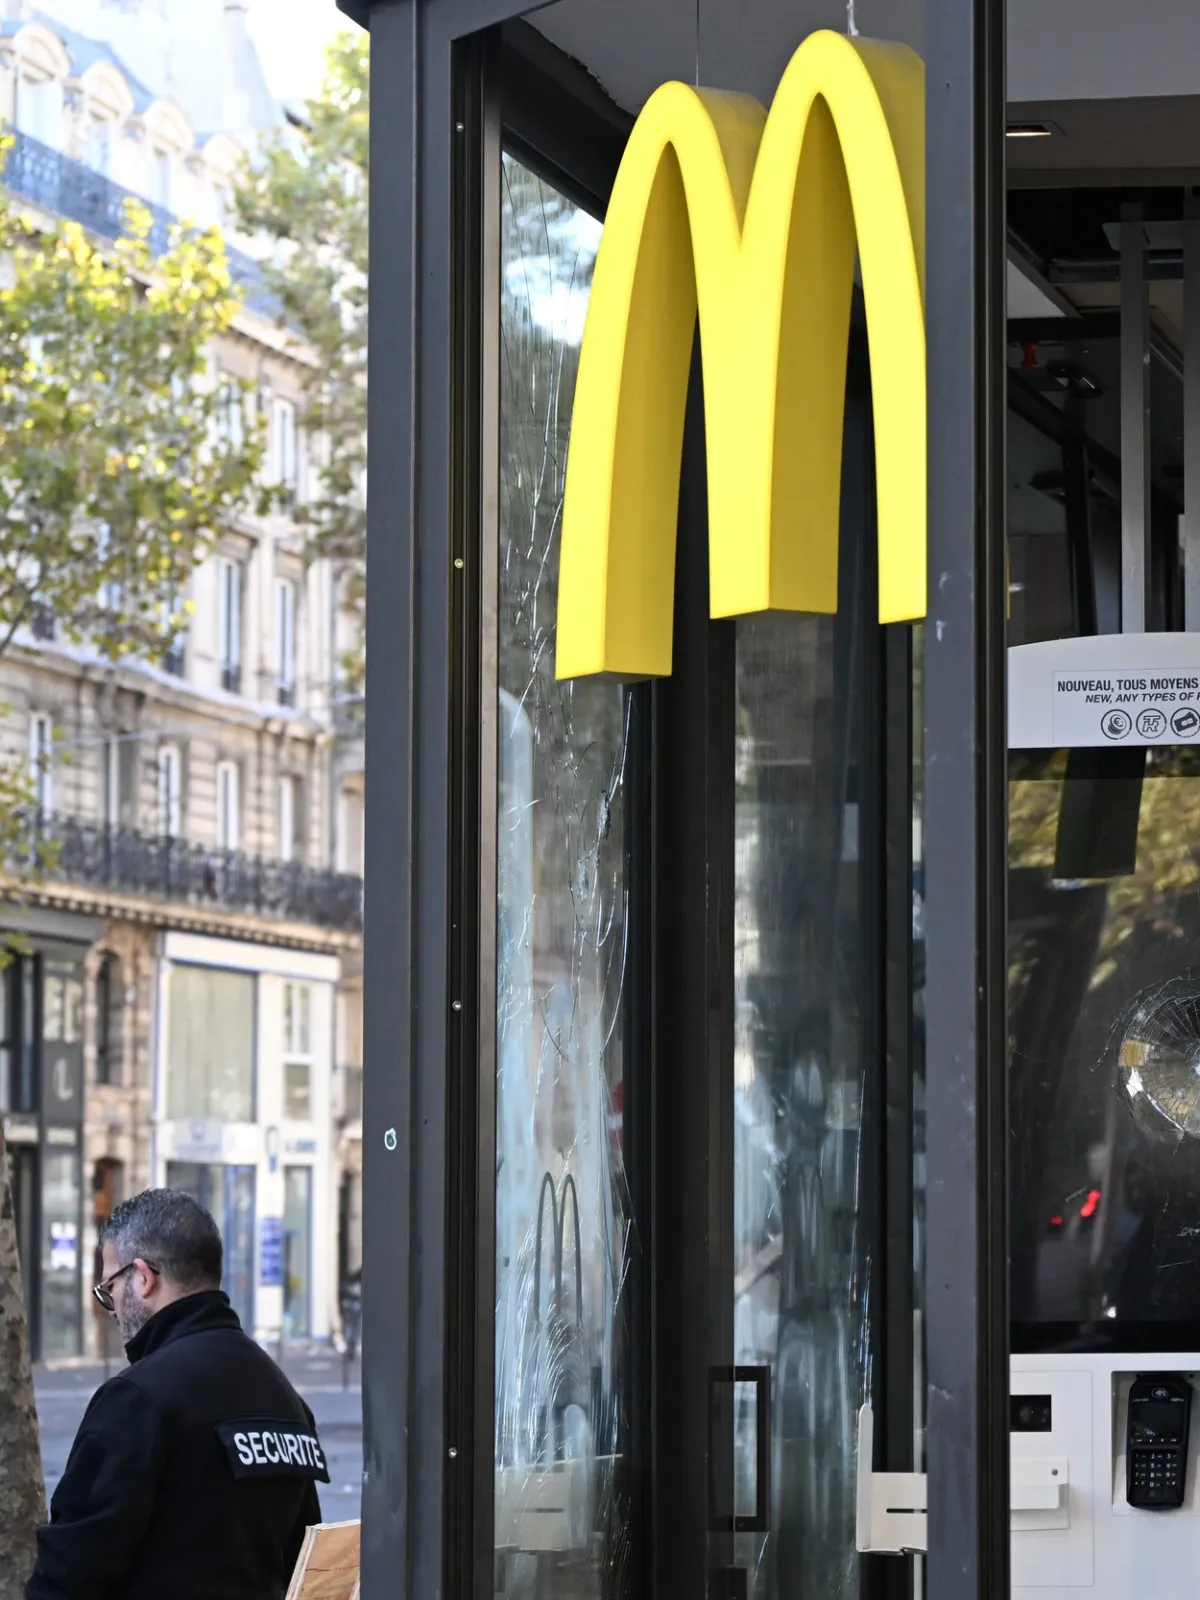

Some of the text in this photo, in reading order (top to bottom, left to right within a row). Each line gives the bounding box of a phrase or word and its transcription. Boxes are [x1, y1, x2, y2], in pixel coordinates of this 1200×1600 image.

[1057, 680, 1115, 693] NOUVEAU,
[1116, 679, 1147, 691] TOUS
[1150, 677, 1199, 690] MOYENS
[1085, 694, 1113, 704] NEW,
[1115, 693, 1139, 703] ANY
[1141, 692, 1177, 702] TYPES
[1179, 691, 1195, 701] OF
[233, 1431, 325, 1470] SECURITE
